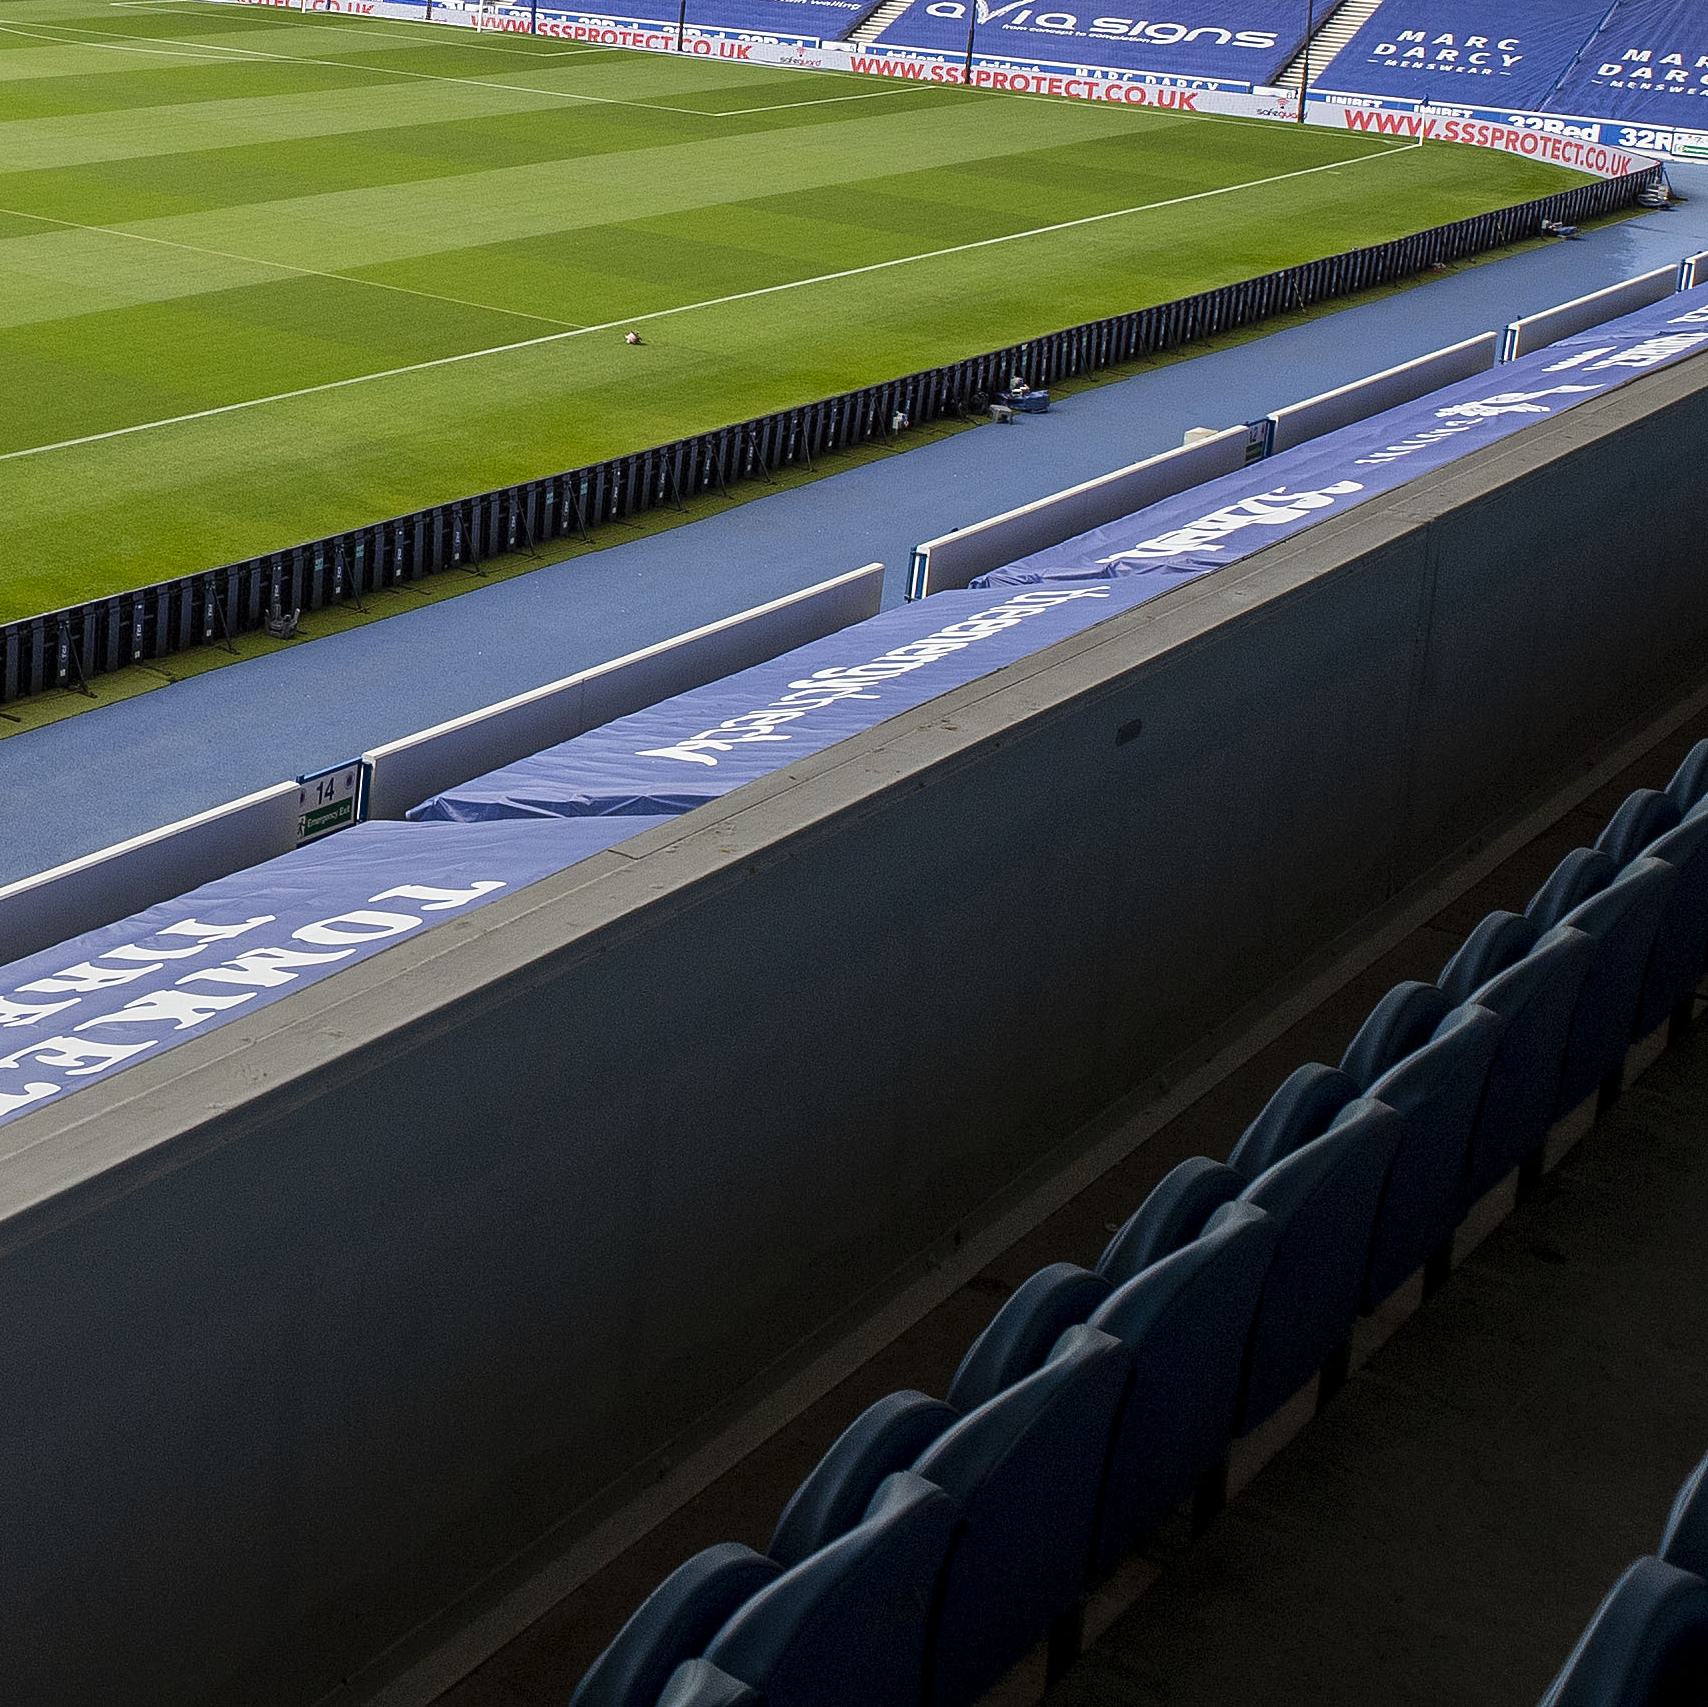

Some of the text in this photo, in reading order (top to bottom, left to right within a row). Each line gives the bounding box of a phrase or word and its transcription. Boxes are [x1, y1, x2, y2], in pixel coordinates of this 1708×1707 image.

[1089, 15, 1280, 49] signs
[1396, 30, 1521, 51] MARC
[1373, 43, 1524, 68] DARCY
[1384, 59, 1493, 76] MENSWEAR
[850, 56, 1197, 112] WWW.SSSPROTECT.CO.UK
[1343, 108, 1633, 176] WWW.SSSPROTECT.CO.UK
[316, 777, 335, 805] 14
[307, 810, 338, 828] Emergency
